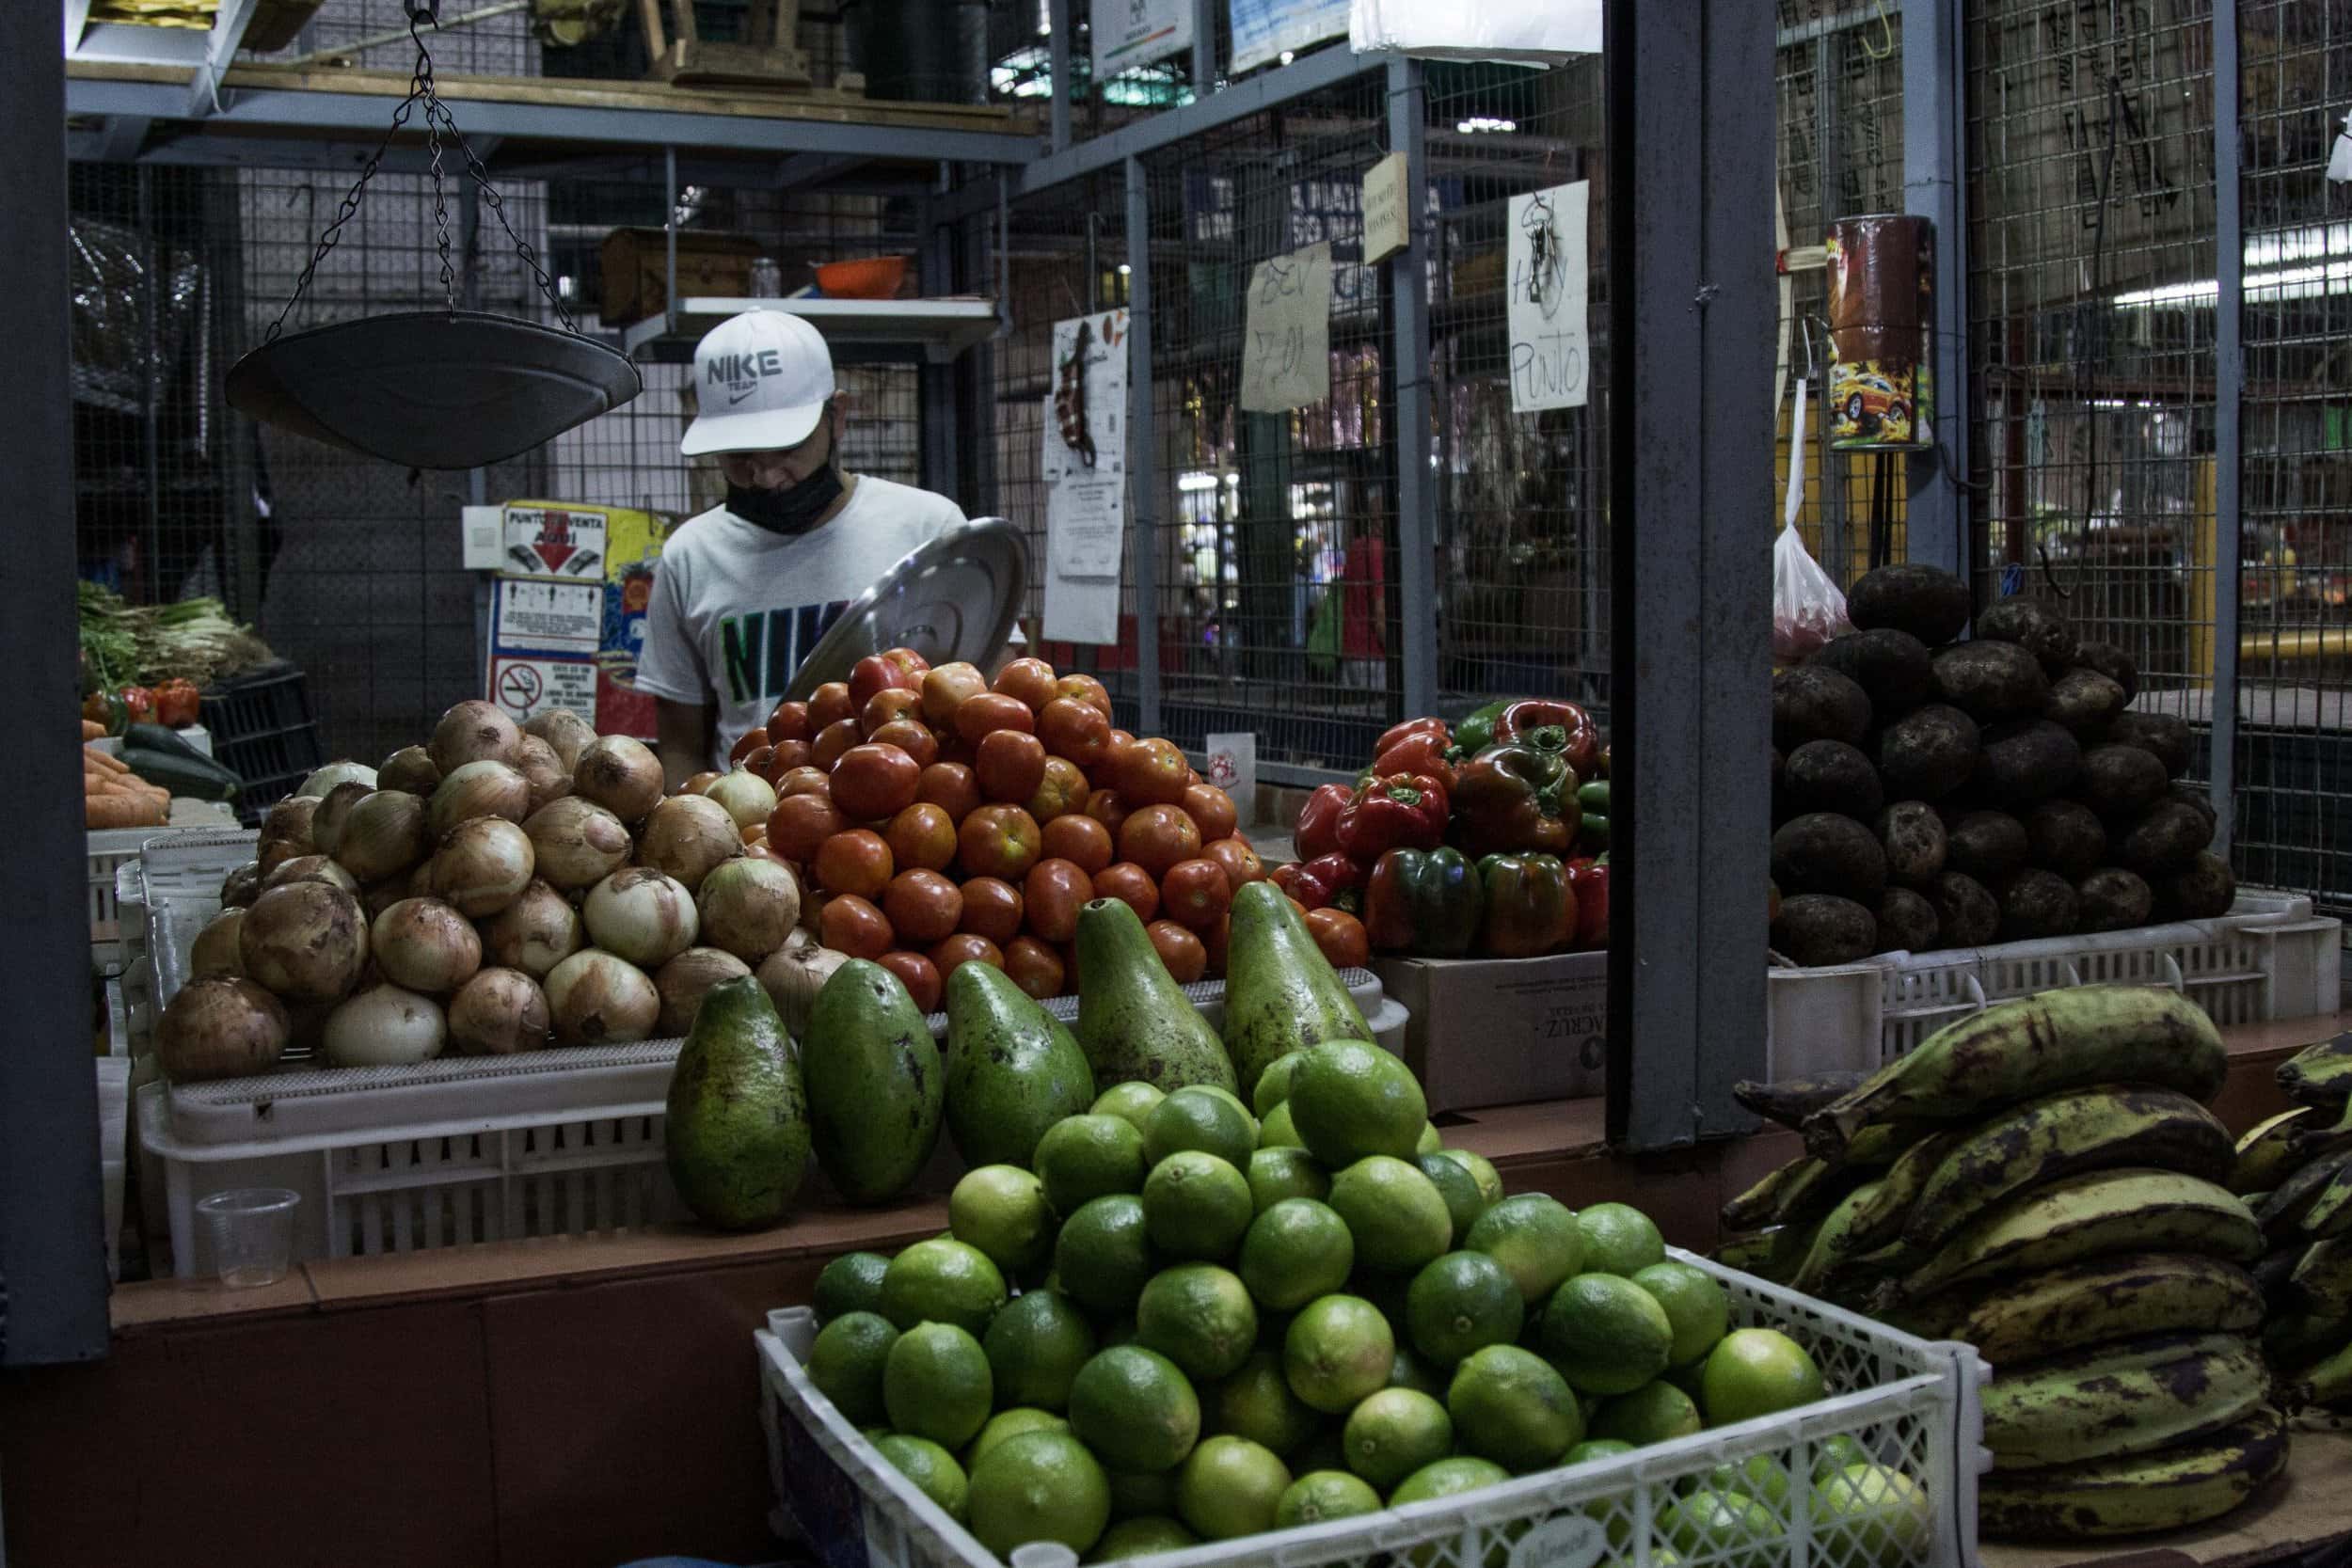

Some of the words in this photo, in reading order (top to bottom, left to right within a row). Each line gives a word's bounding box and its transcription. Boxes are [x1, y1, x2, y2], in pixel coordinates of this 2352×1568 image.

[707, 350, 783, 385] NIKE
[1511, 329, 1581, 407] PUNTO
[727, 380, 758, 392] TEAM
[509, 511, 548, 525] PUNTO
[566, 516, 603, 530] VENTA
